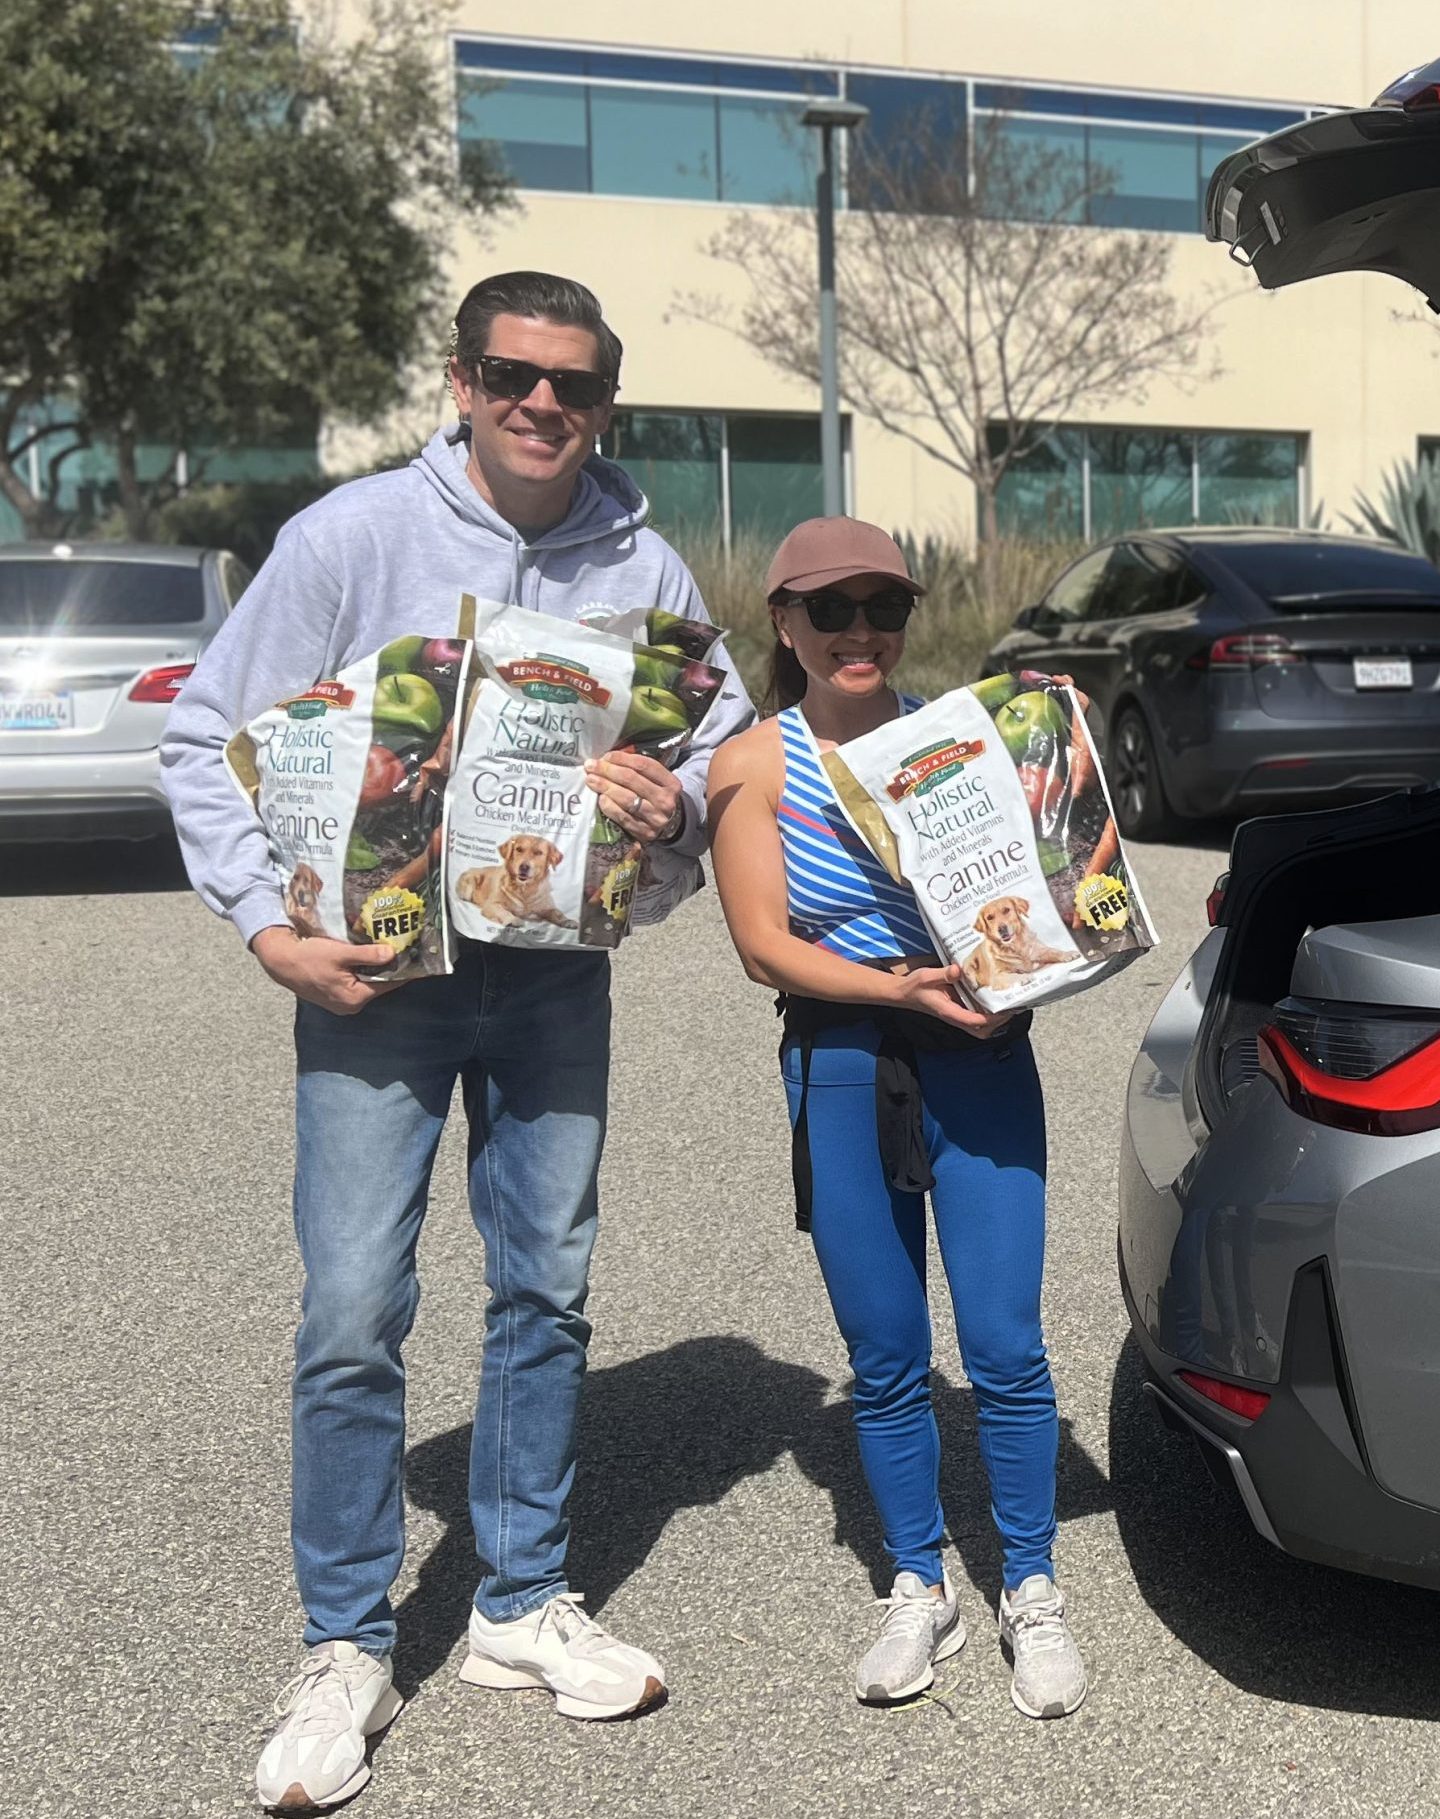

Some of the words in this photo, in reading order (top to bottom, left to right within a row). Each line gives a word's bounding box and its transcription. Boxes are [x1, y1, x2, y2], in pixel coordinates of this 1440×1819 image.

[315, 686, 339, 697] FIELD
[513, 666, 551, 678] BENCH
[553, 671, 561, 679] &
[563, 674, 592, 692] FIELD
[499, 699, 585, 733] Holistic
[269, 724, 334, 749] Holistic
[493, 719, 579, 757] Natural
[269, 750, 332, 774] Natural
[504, 763, 523, 774] and
[525, 763, 560, 779] Minerals
[932, 758, 939, 766] &
[941, 747, 967, 762] FIELD
[298, 777, 334, 791] Vitamins
[472, 771, 581, 816] Canine
[475, 805, 515, 822] Chicken
[518, 811, 540, 825] Meal
[907, 775, 986, 831] Holistic
[918, 791, 995, 848] Natural
[266, 804, 339, 841] Canine
[940, 830, 967, 851] Added
[966, 815, 1005, 837] Vitamins
[942, 851, 958, 867] and
[956, 834, 993, 856] Minerals
[927, 840, 1026, 903] Canine
[373, 895, 405, 908] 100%
[940, 892, 973, 916] Chicken
[972, 881, 994, 898] Meal
[993, 863, 1029, 887] Formula
[1089, 889, 1128, 926] FREE
[372, 911, 420, 941] FREE
